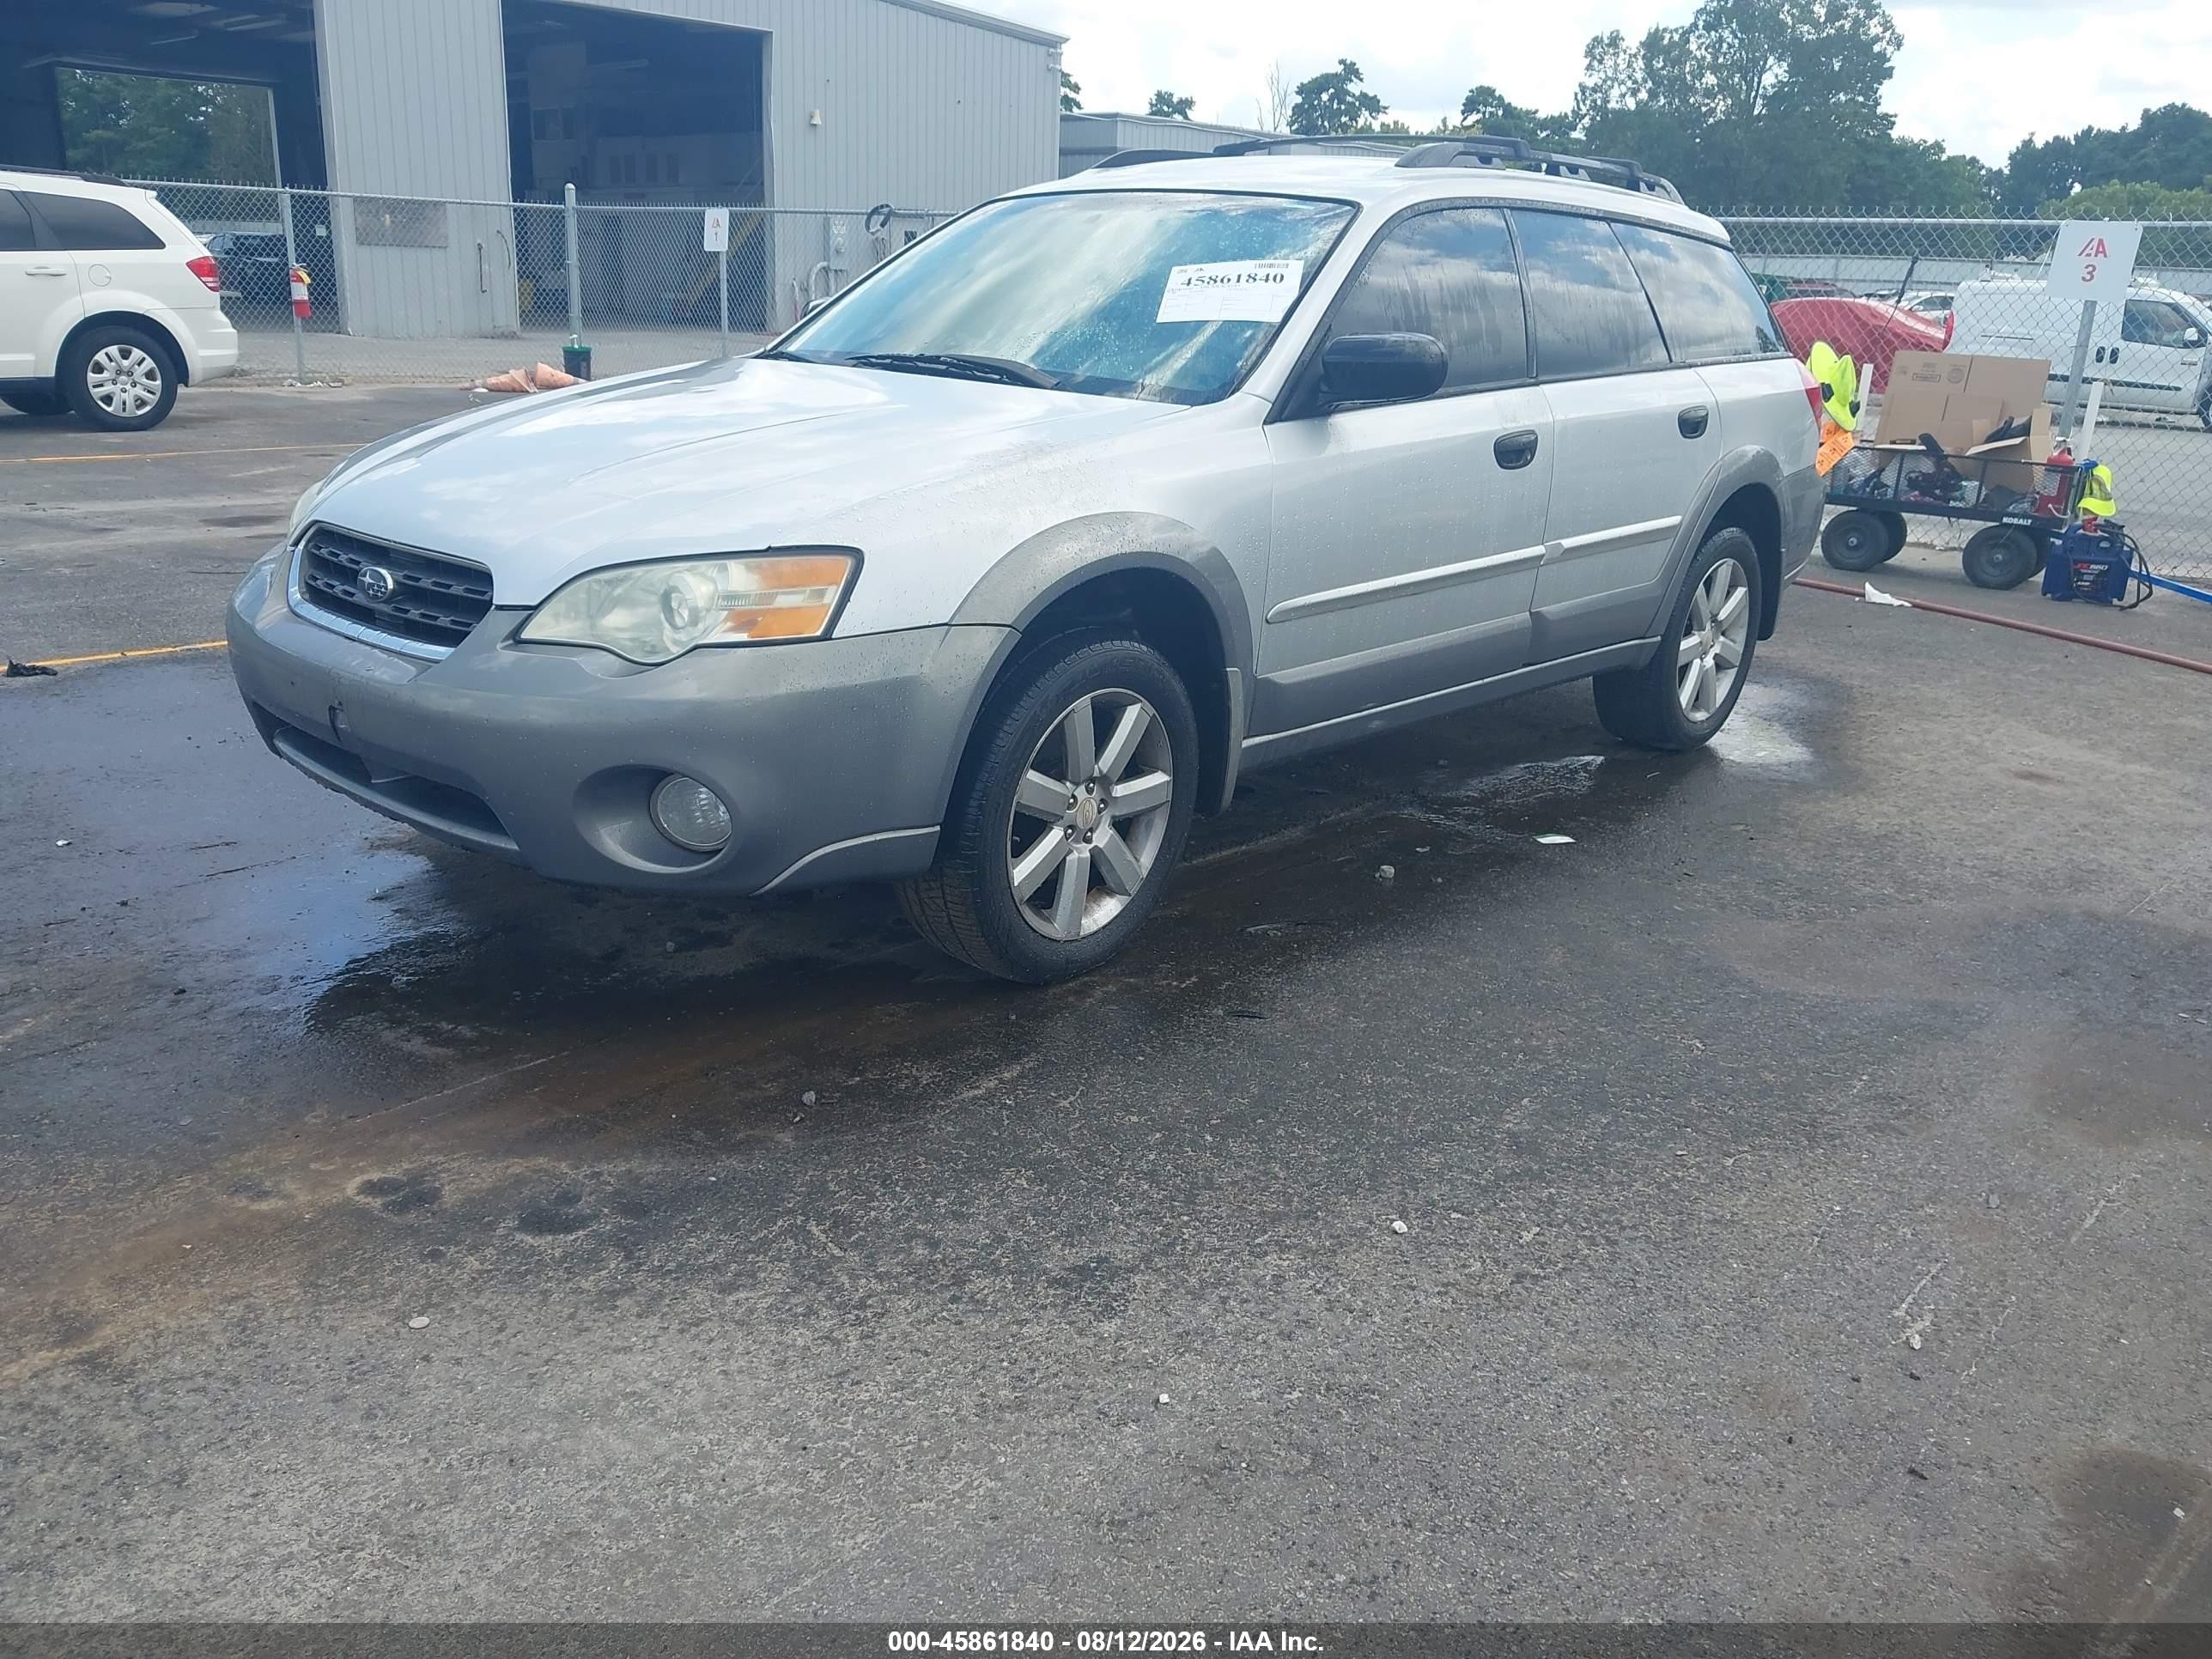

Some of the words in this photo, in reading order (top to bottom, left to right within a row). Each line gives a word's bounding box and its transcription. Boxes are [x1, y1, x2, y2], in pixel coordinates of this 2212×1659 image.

[1181, 272, 1285, 287] 45861840
[2081, 264, 2097, 283] 3
[2002, 516, 2033, 526] KOBALT
